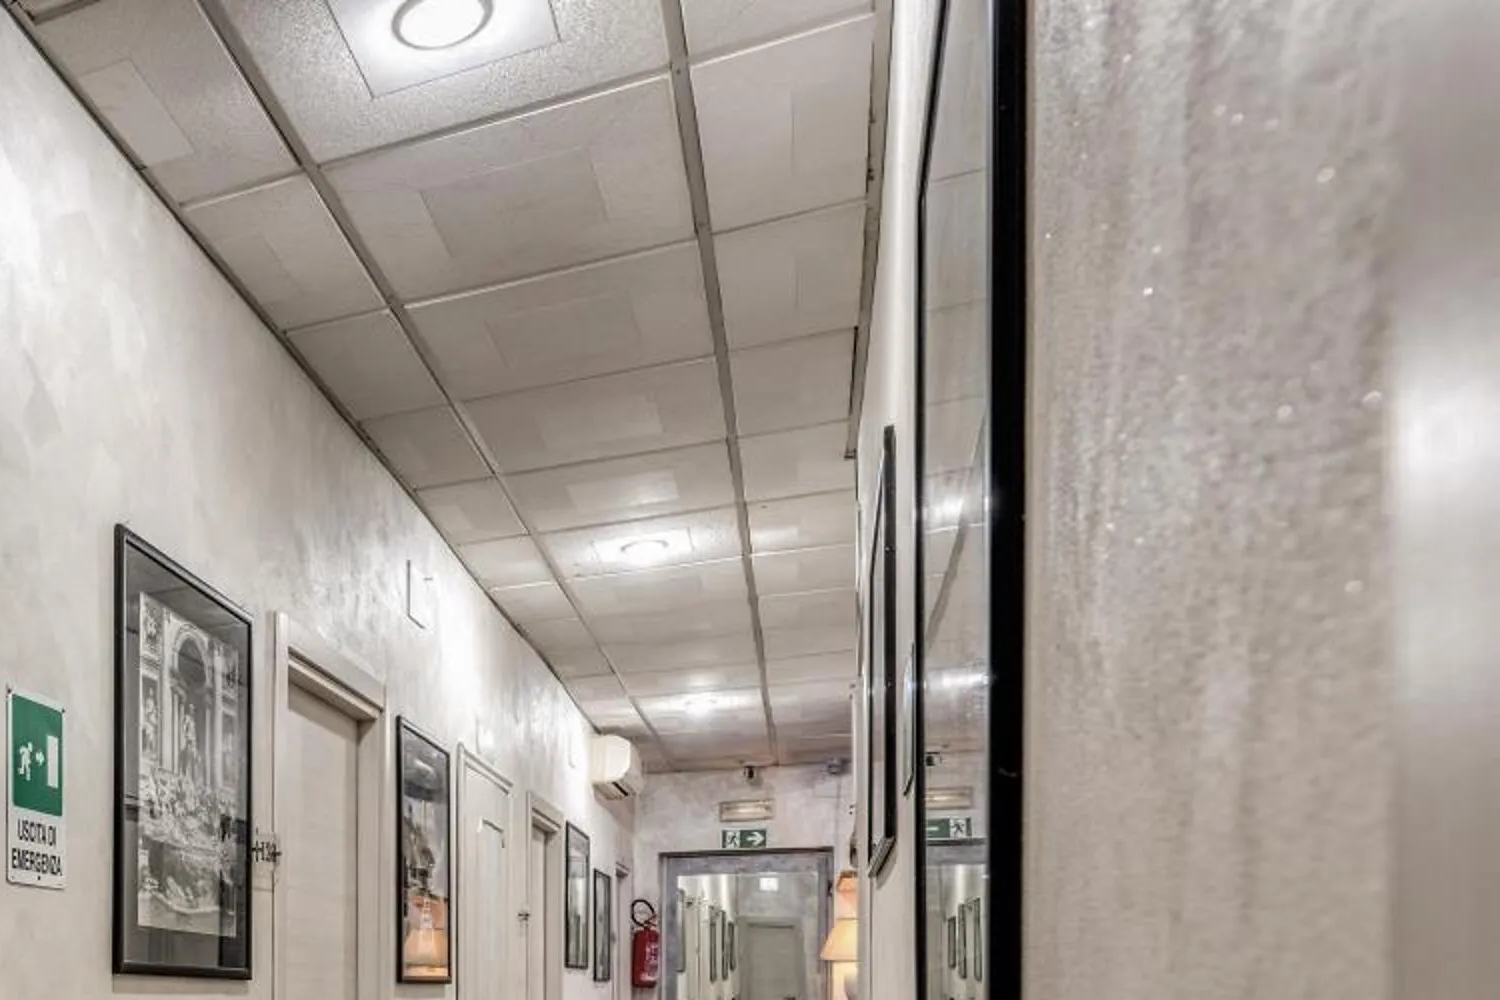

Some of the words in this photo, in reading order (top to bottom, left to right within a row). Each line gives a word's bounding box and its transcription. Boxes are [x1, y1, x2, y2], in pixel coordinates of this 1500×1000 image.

[18, 819, 46, 843] USCITA
[48, 825, 57, 847] DI
[12, 848, 62, 876] EMERGENZA
